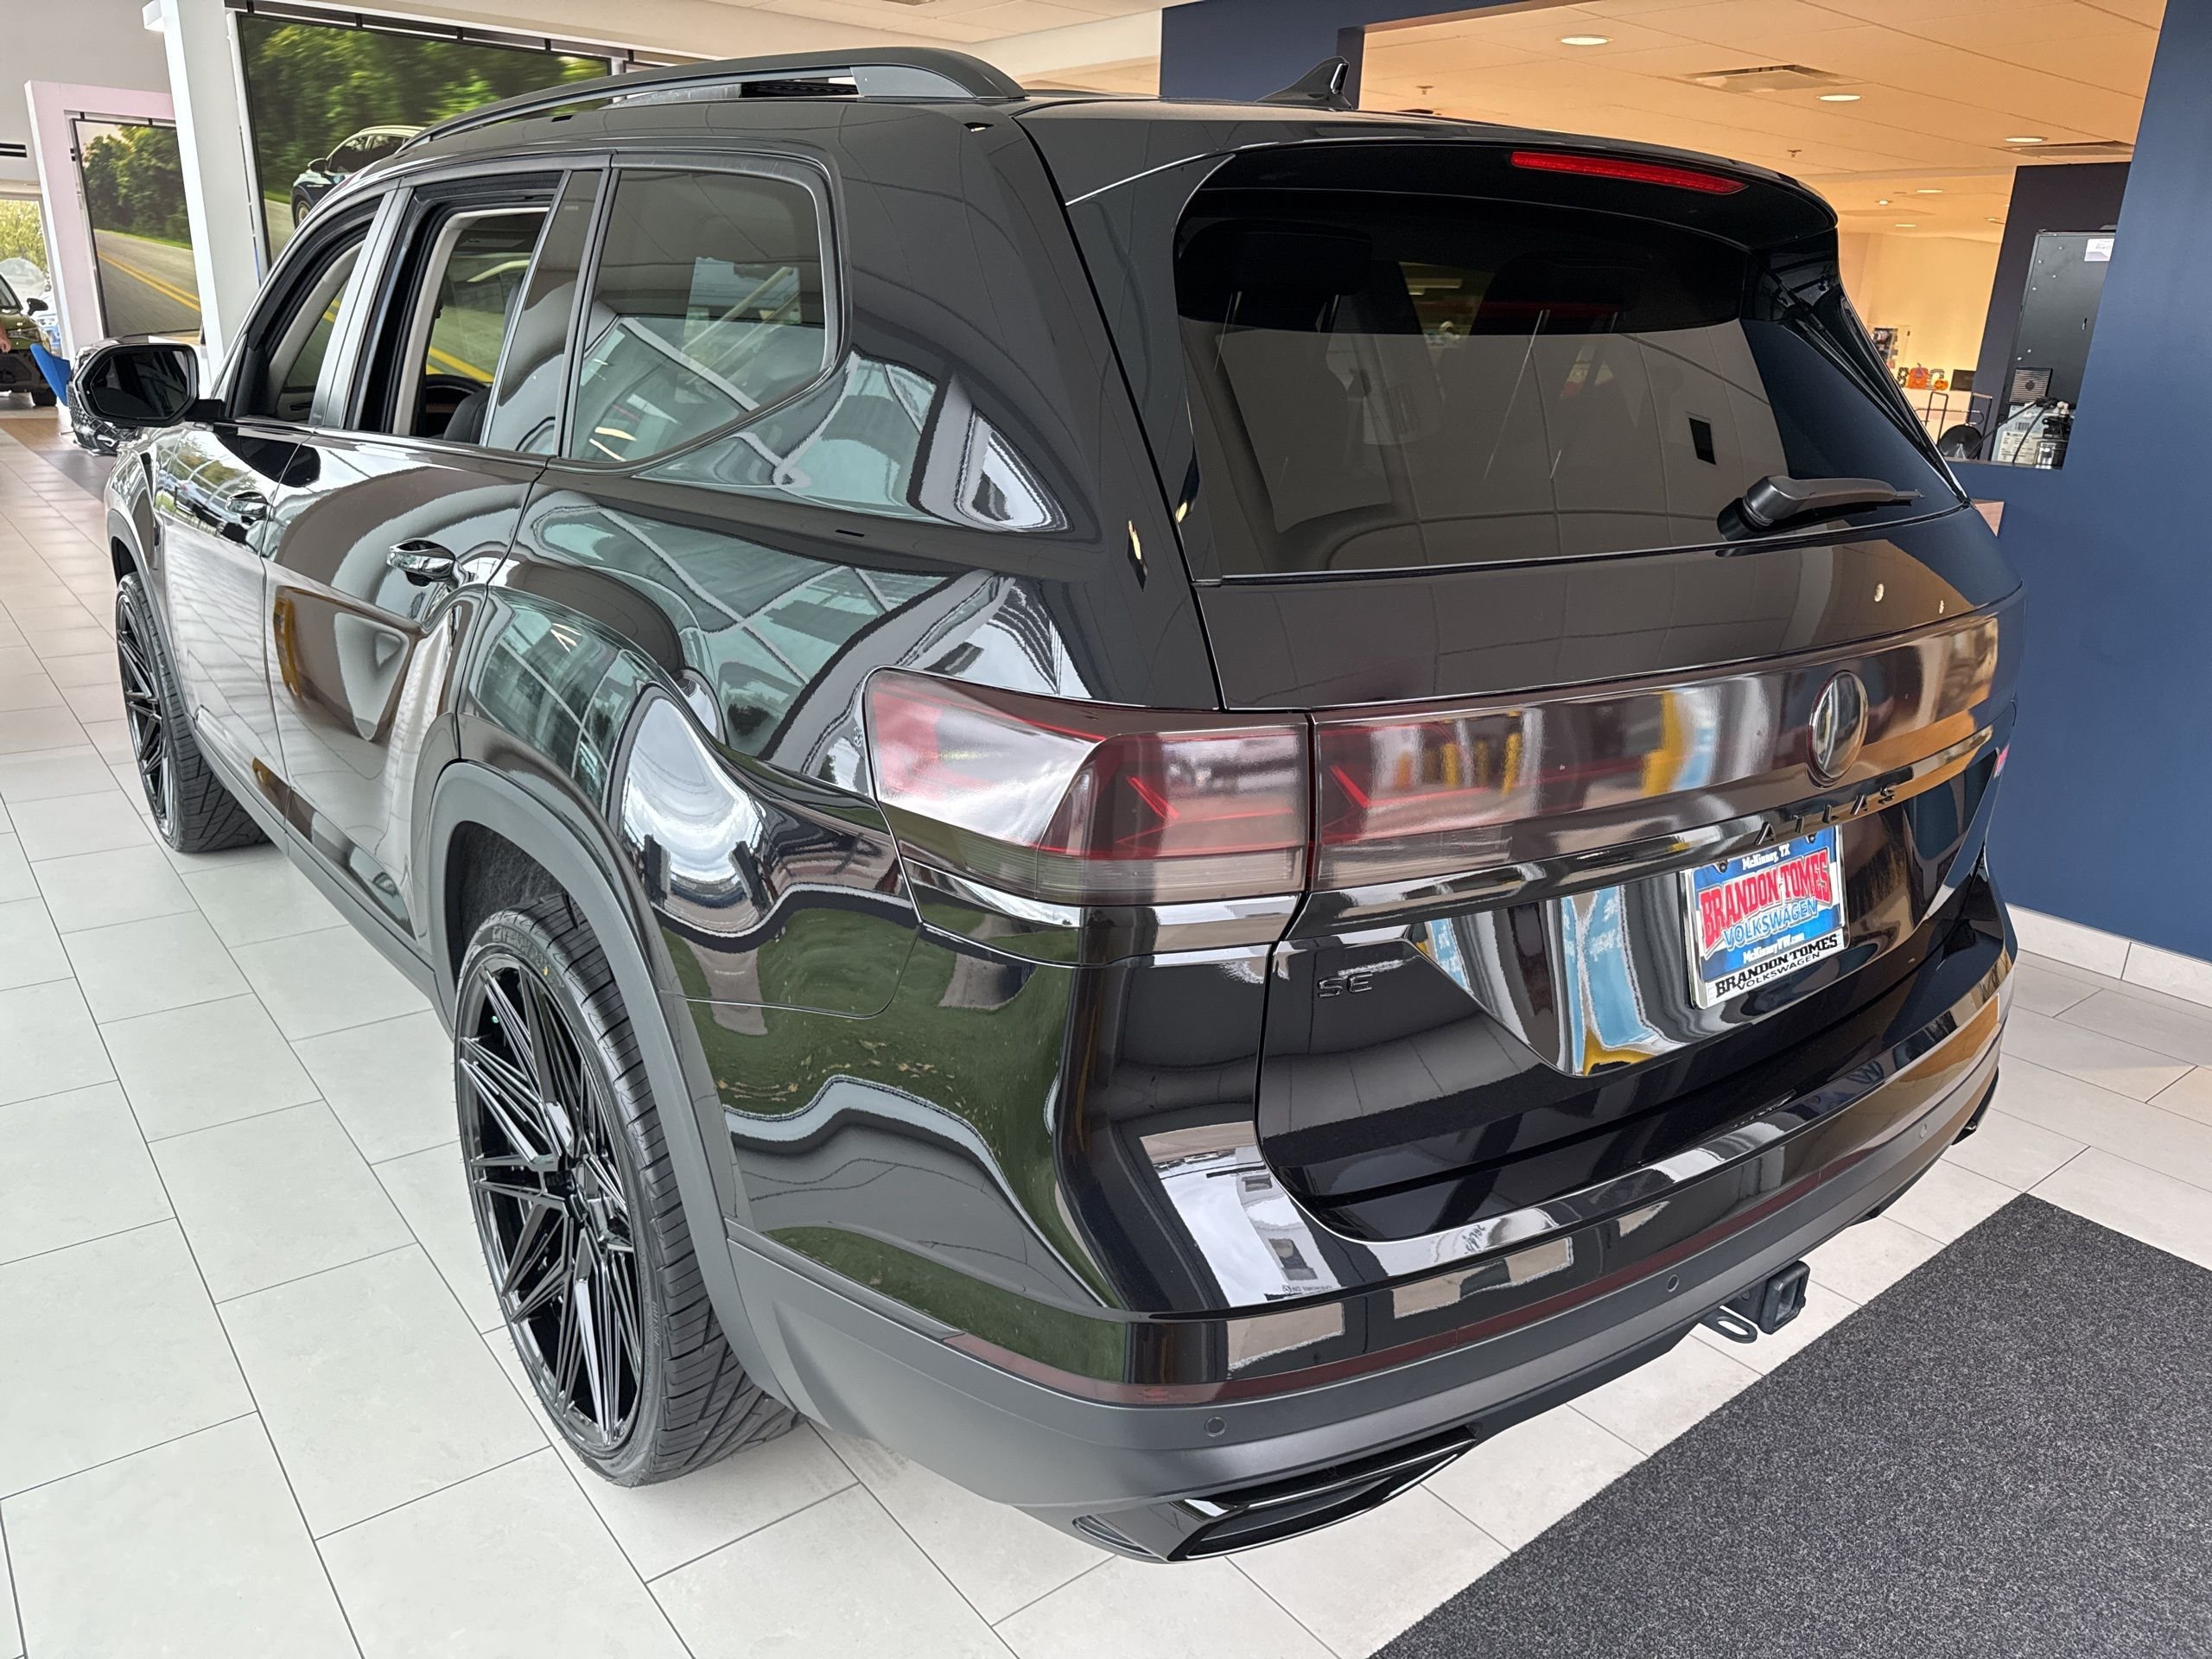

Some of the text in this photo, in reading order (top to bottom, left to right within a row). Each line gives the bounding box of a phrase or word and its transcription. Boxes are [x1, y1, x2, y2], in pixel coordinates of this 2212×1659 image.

[1754, 782, 1898, 846] ATLAS
[1741, 842, 1790, 871] McKinney, TX
[1700, 849, 1833, 950] BRANDON TOMES
[1723, 898, 1818, 947] VOLKSWAGEN
[1715, 933, 1838, 998] BRANDON TOMES
[1743, 932, 1804, 963] McKinneyVW.com
[1318, 971, 1373, 998] SE
[1736, 950, 1821, 991] VOLKSWAGEN
